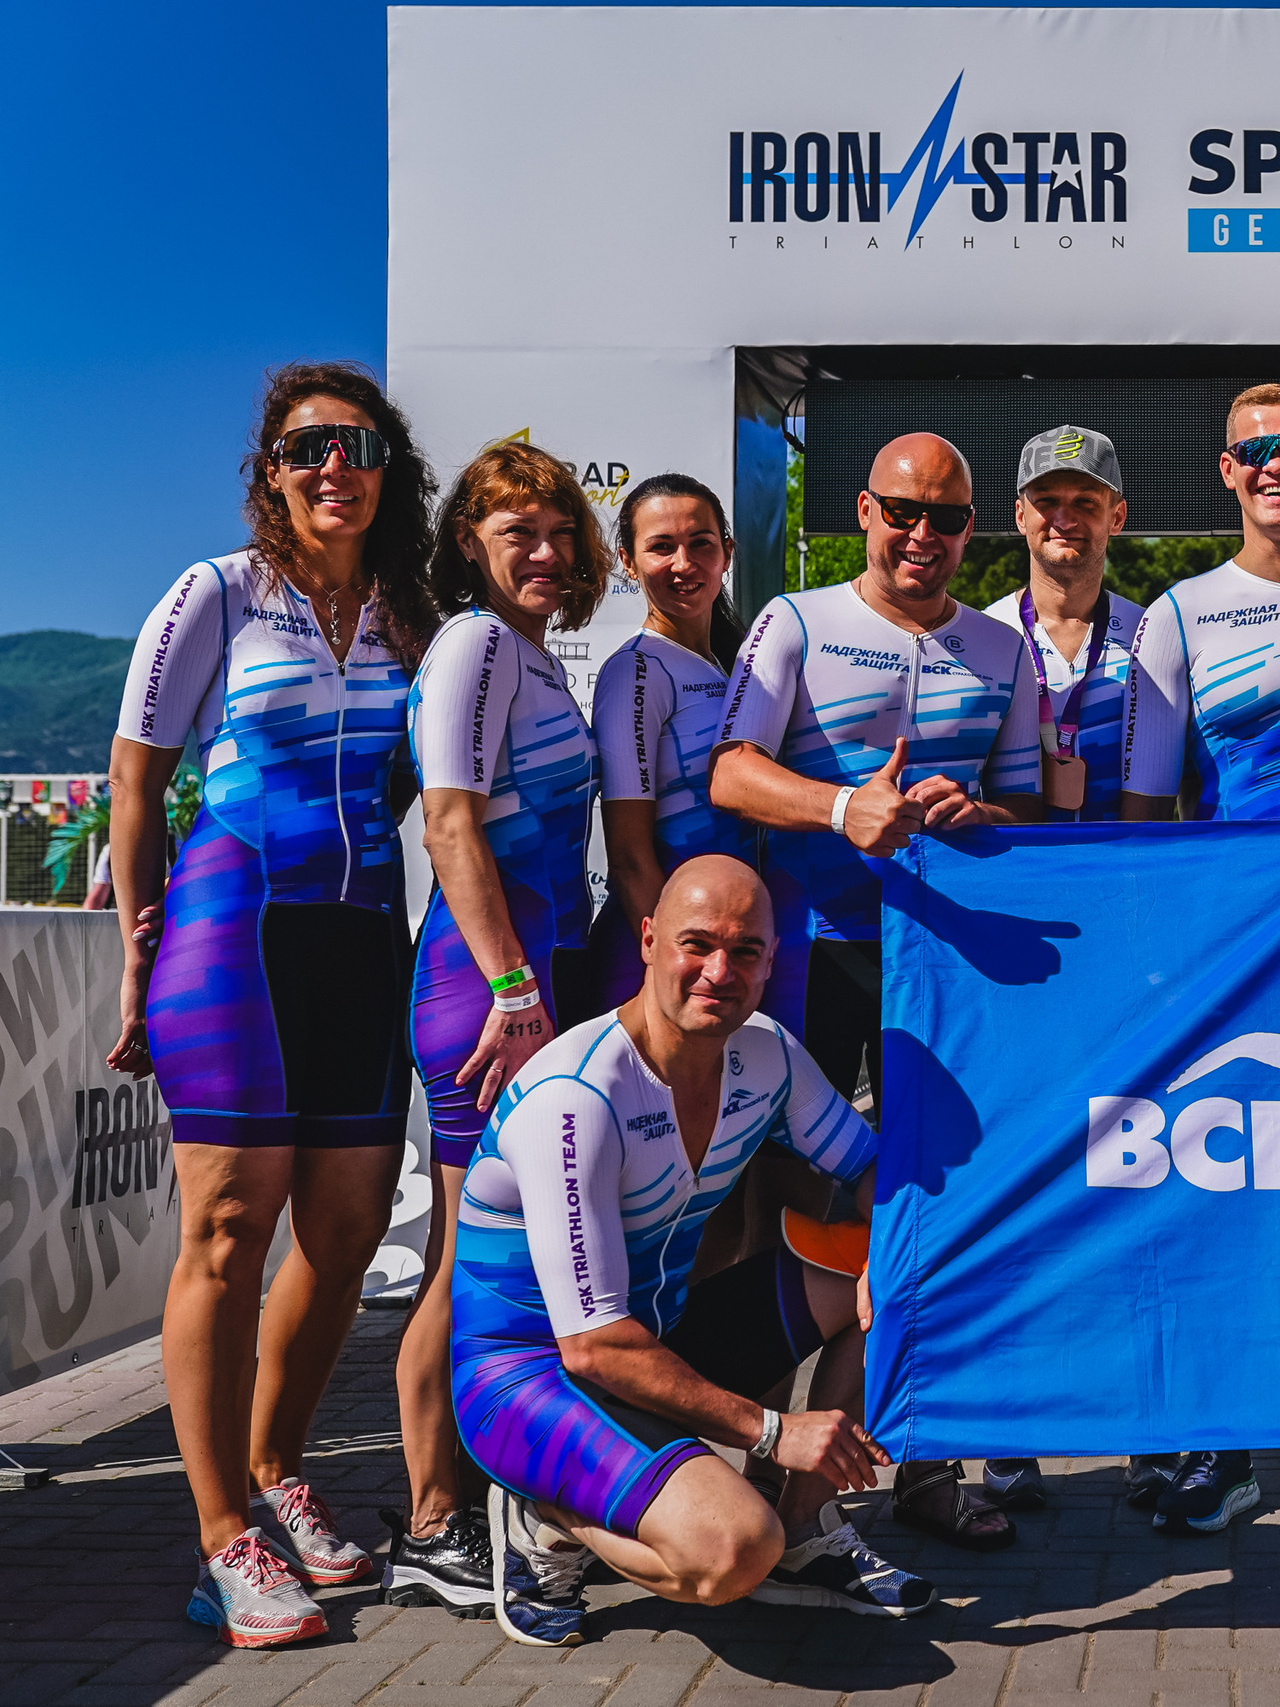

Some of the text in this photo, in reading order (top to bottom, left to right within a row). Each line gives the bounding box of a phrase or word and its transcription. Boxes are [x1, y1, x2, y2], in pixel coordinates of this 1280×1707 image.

[729, 131, 1128, 223] IRON STAR
[729, 235, 1125, 250] TRIATHLON
[272, 621, 322, 638] ЗАЩИТА
[1197, 603, 1278, 625] НАДЕЖНАЯ
[140, 573, 198, 739] VSK TRIATHLON TEAM
[726, 654, 755, 720] TRIATHLON
[750, 613, 774, 650] TEAM
[820, 643, 900, 662] НАДЕЖНАЯ
[850, 657, 910, 673] ЗАЩИТА
[922, 664, 952, 675] ВСК
[473, 624, 500, 783] VSK TRIATHLON TEAM
[682, 681, 727, 693] НАДЕЖНАЯ
[1123, 616, 1149, 782] VSK TRIATHLON TEAM
[633, 652, 651, 794] VSK TRIATHLON TEAM
[503, 1019, 543, 1037] 4113
[71, 1079, 159, 1209] IRON
[562, 1113, 596, 1318] VSK TRIATHLON TEAM
